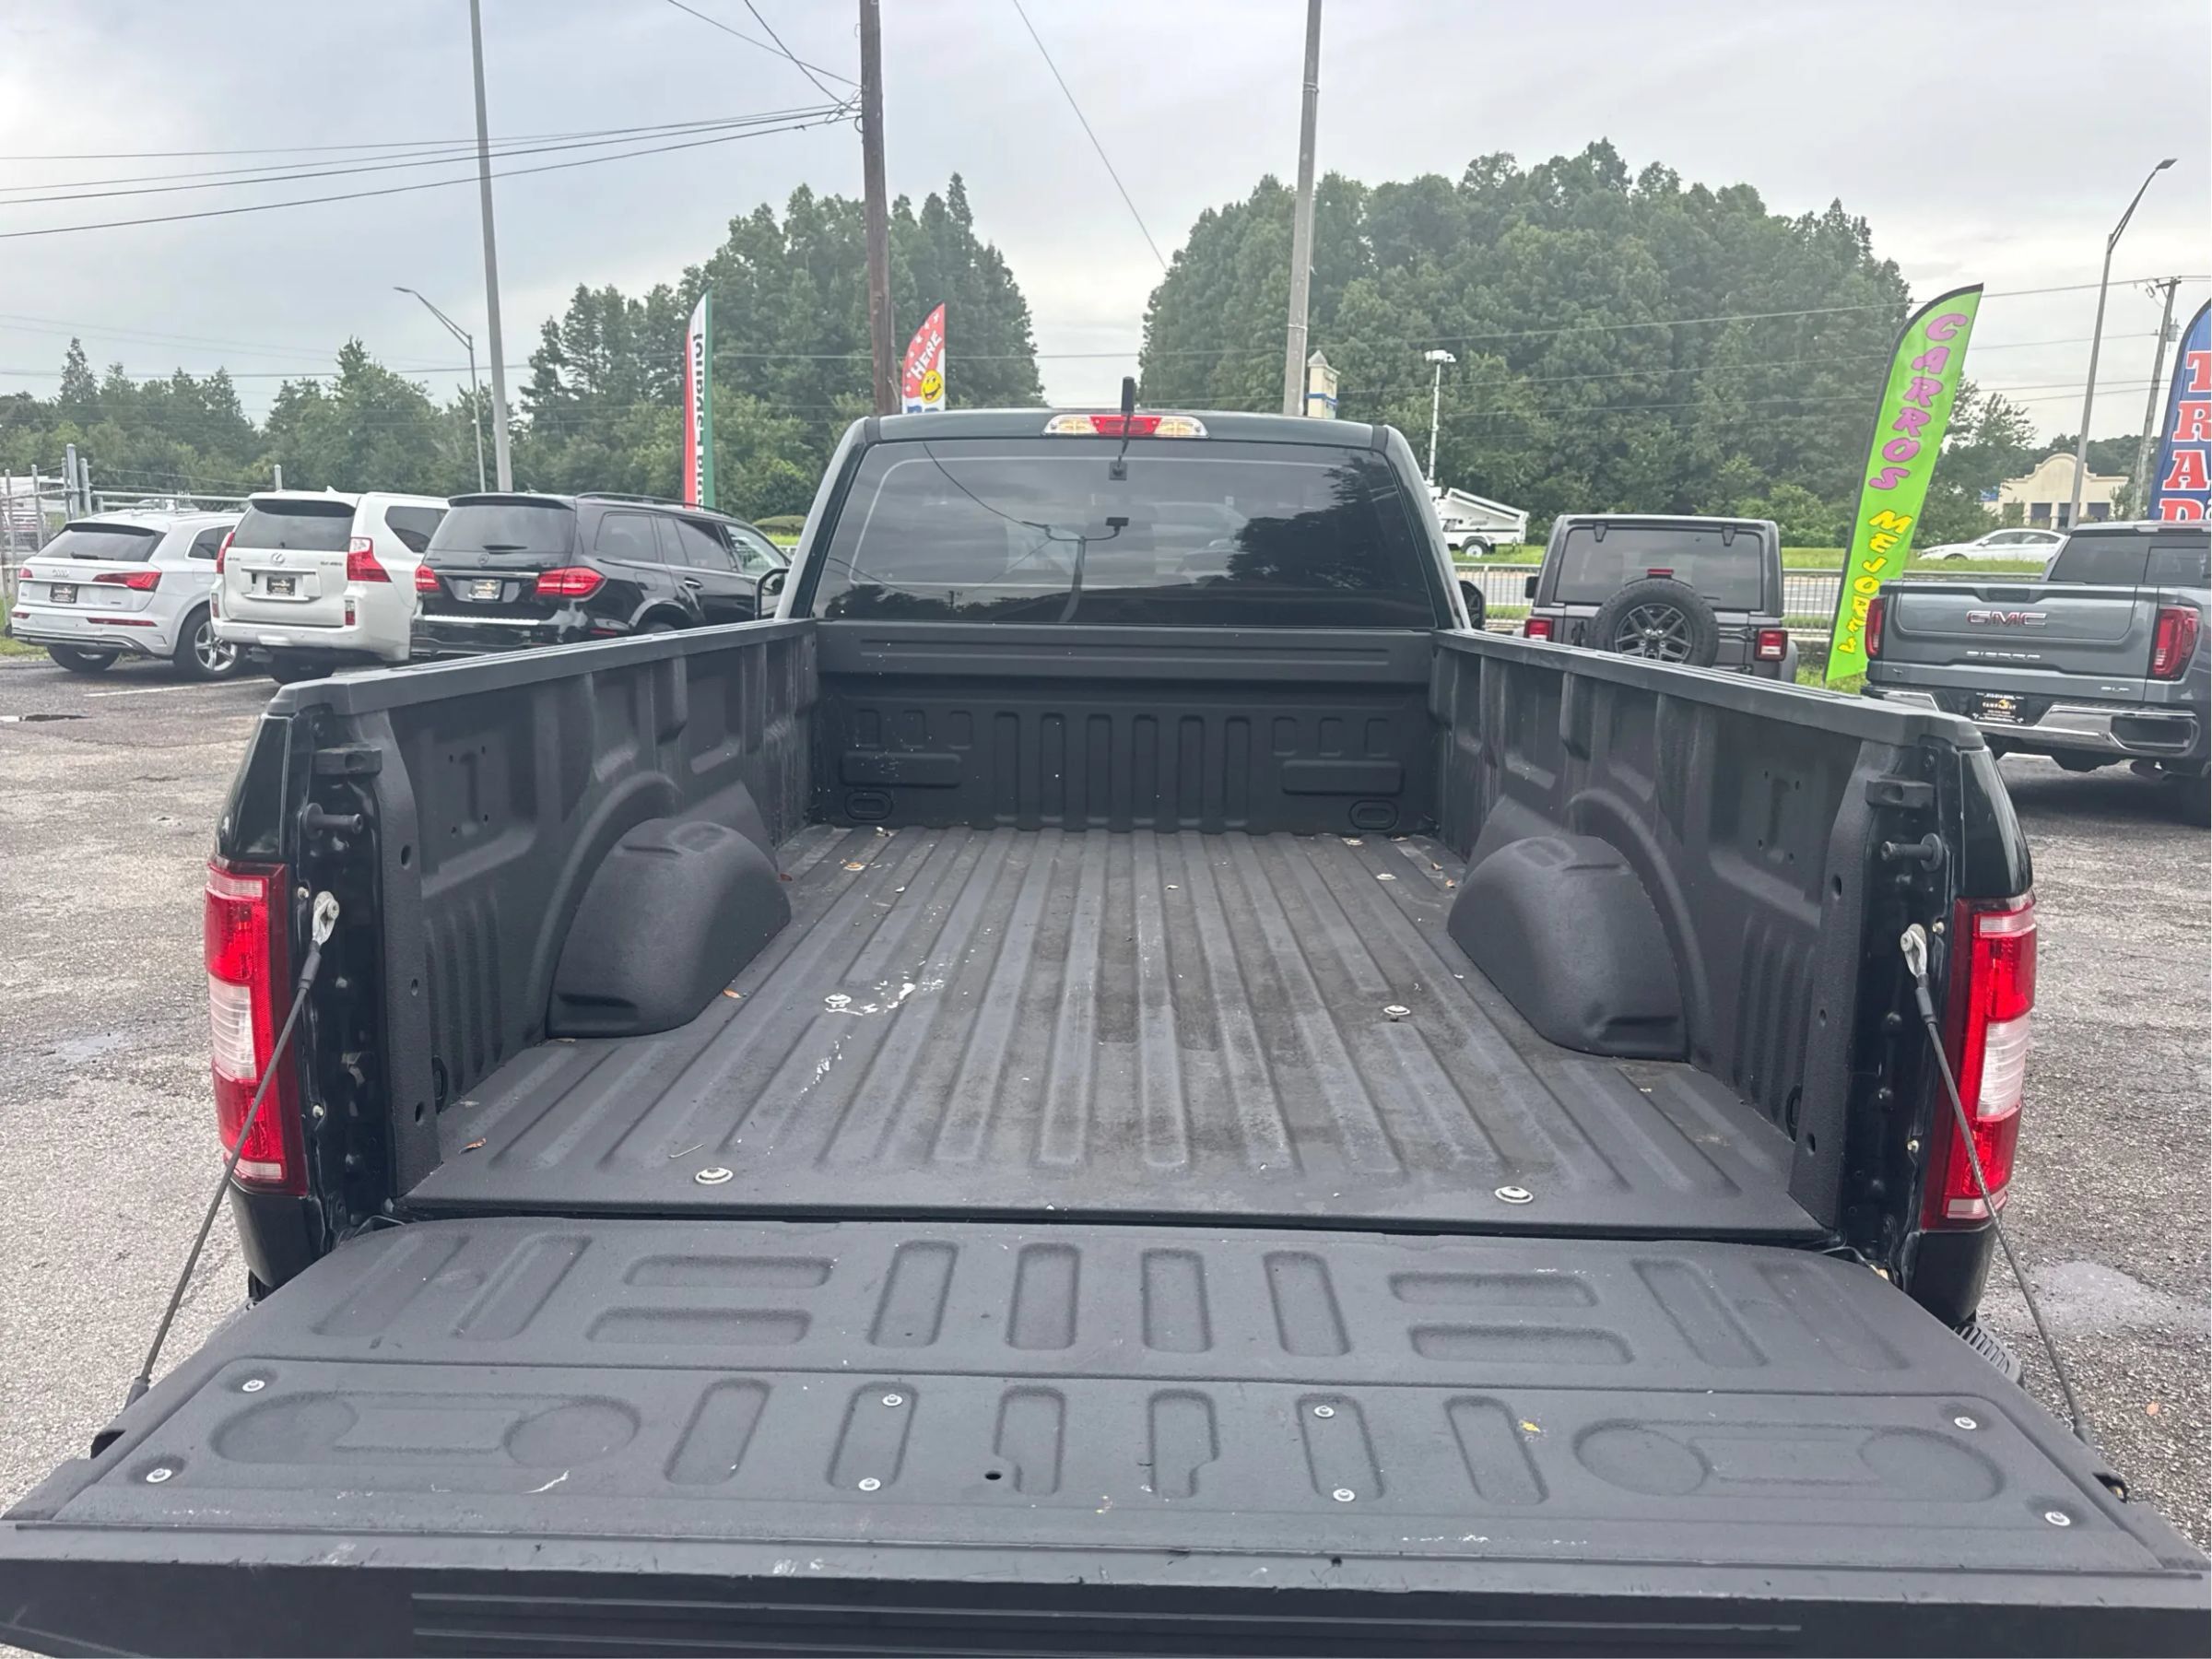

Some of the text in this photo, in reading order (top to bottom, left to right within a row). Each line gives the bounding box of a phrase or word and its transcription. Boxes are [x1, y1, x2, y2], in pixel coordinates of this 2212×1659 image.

[910, 329, 943, 381] HERE
[1868, 313, 1969, 490] CARROS
[1966, 609, 2048, 629] GMC
